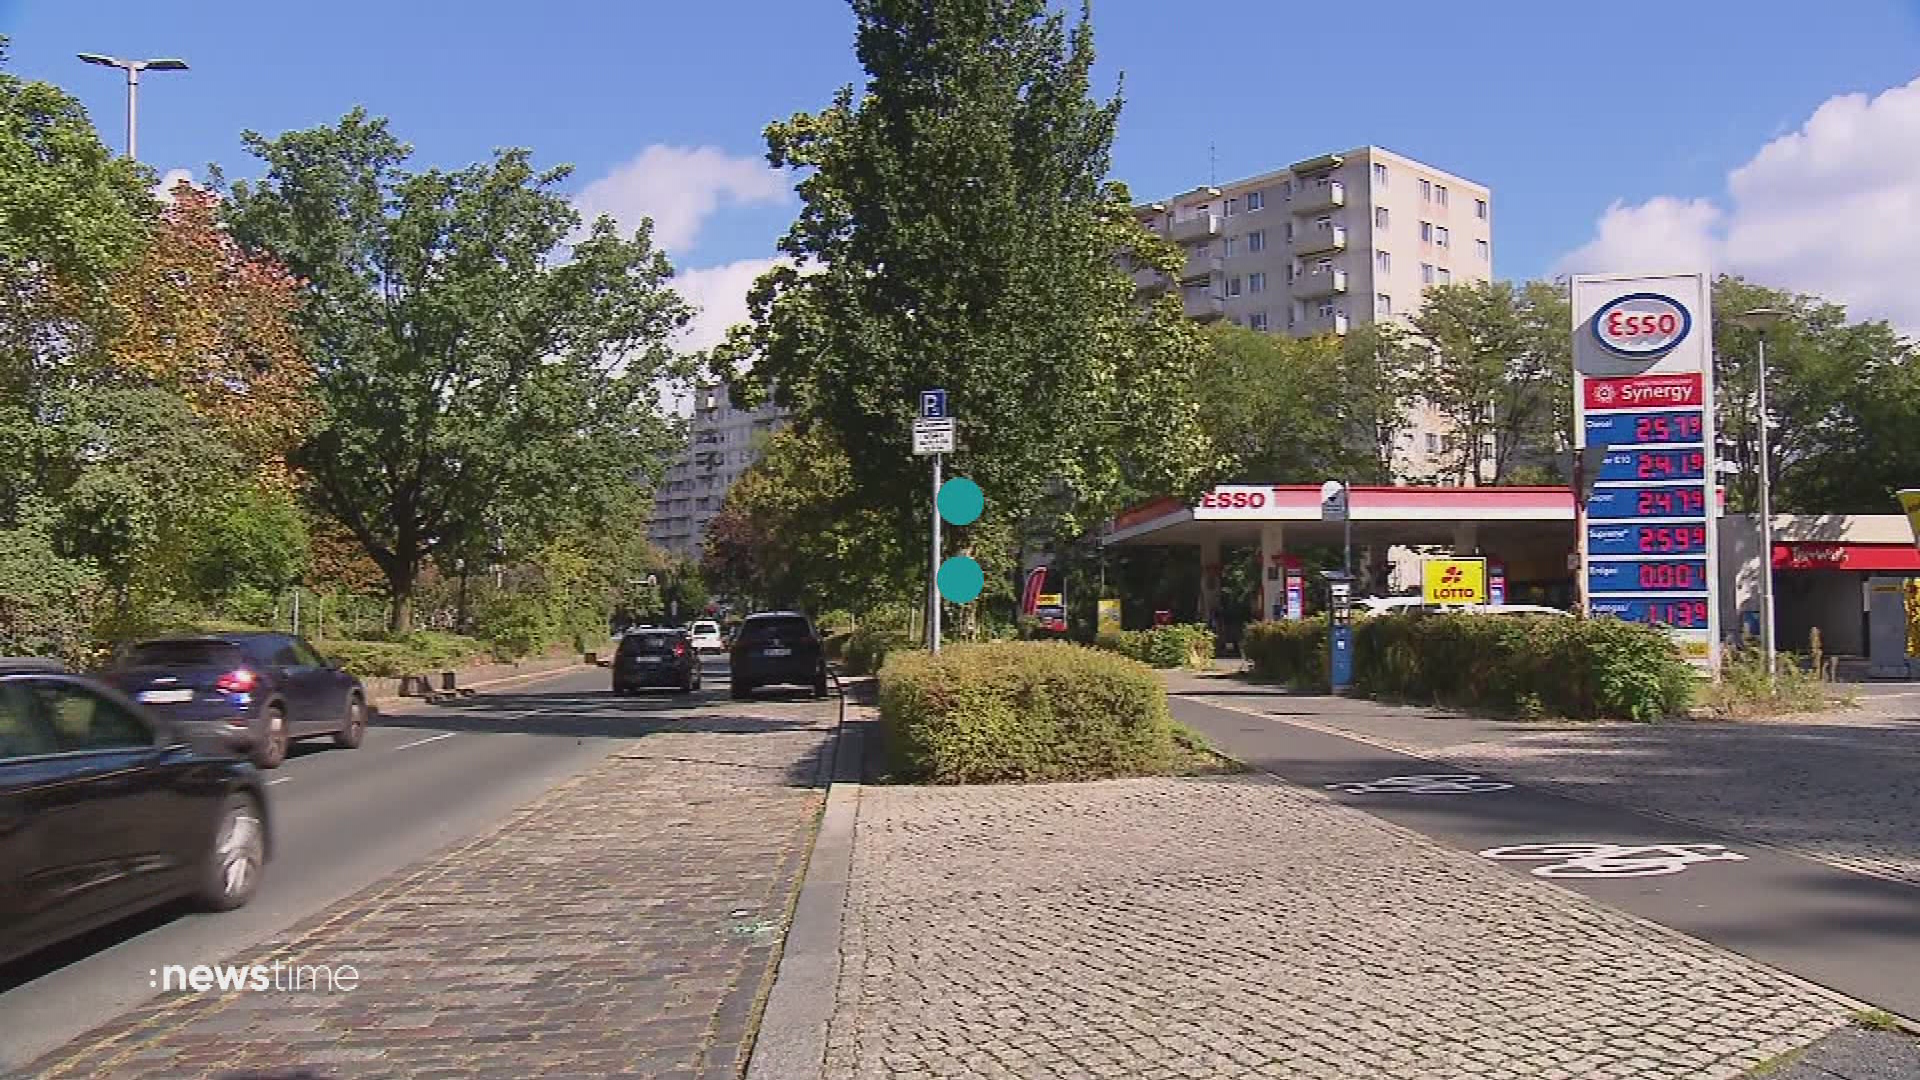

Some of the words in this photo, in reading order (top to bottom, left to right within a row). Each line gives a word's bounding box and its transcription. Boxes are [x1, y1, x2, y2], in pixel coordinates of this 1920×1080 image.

[1621, 383, 1693, 404] Synergy
[923, 395, 938, 416] P
[1202, 492, 1266, 509] ESSO
[1433, 588, 1475, 600] LOTTO
